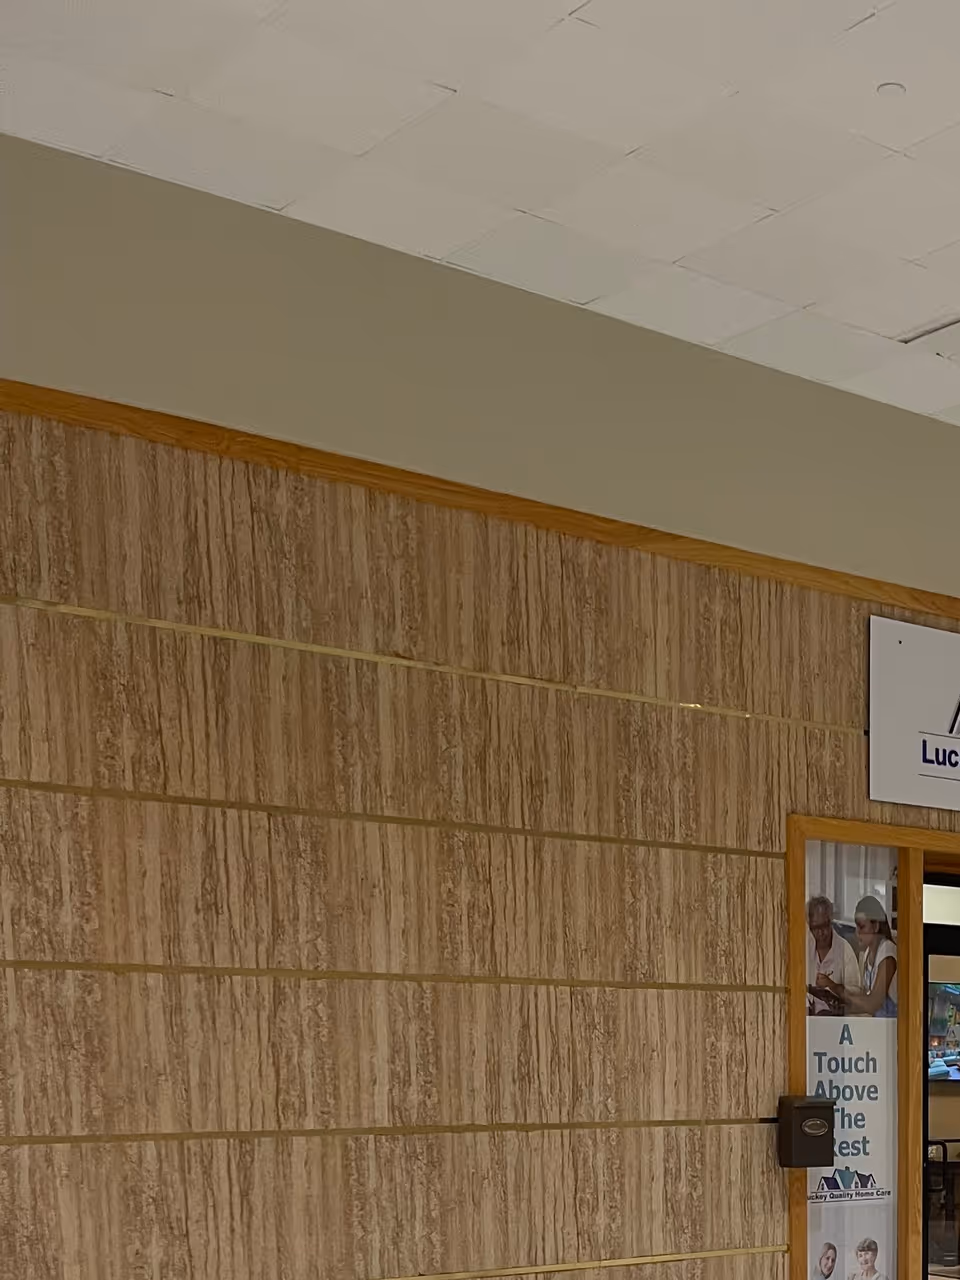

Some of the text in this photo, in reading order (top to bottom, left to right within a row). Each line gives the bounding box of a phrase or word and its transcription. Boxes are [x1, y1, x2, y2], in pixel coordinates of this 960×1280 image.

[839, 1023, 854, 1045] A
[813, 1051, 877, 1074] Touch
[813, 1079, 879, 1101] Above
[806, 1193, 827, 1202] uckey
[829, 1191, 853, 1200] Quality
